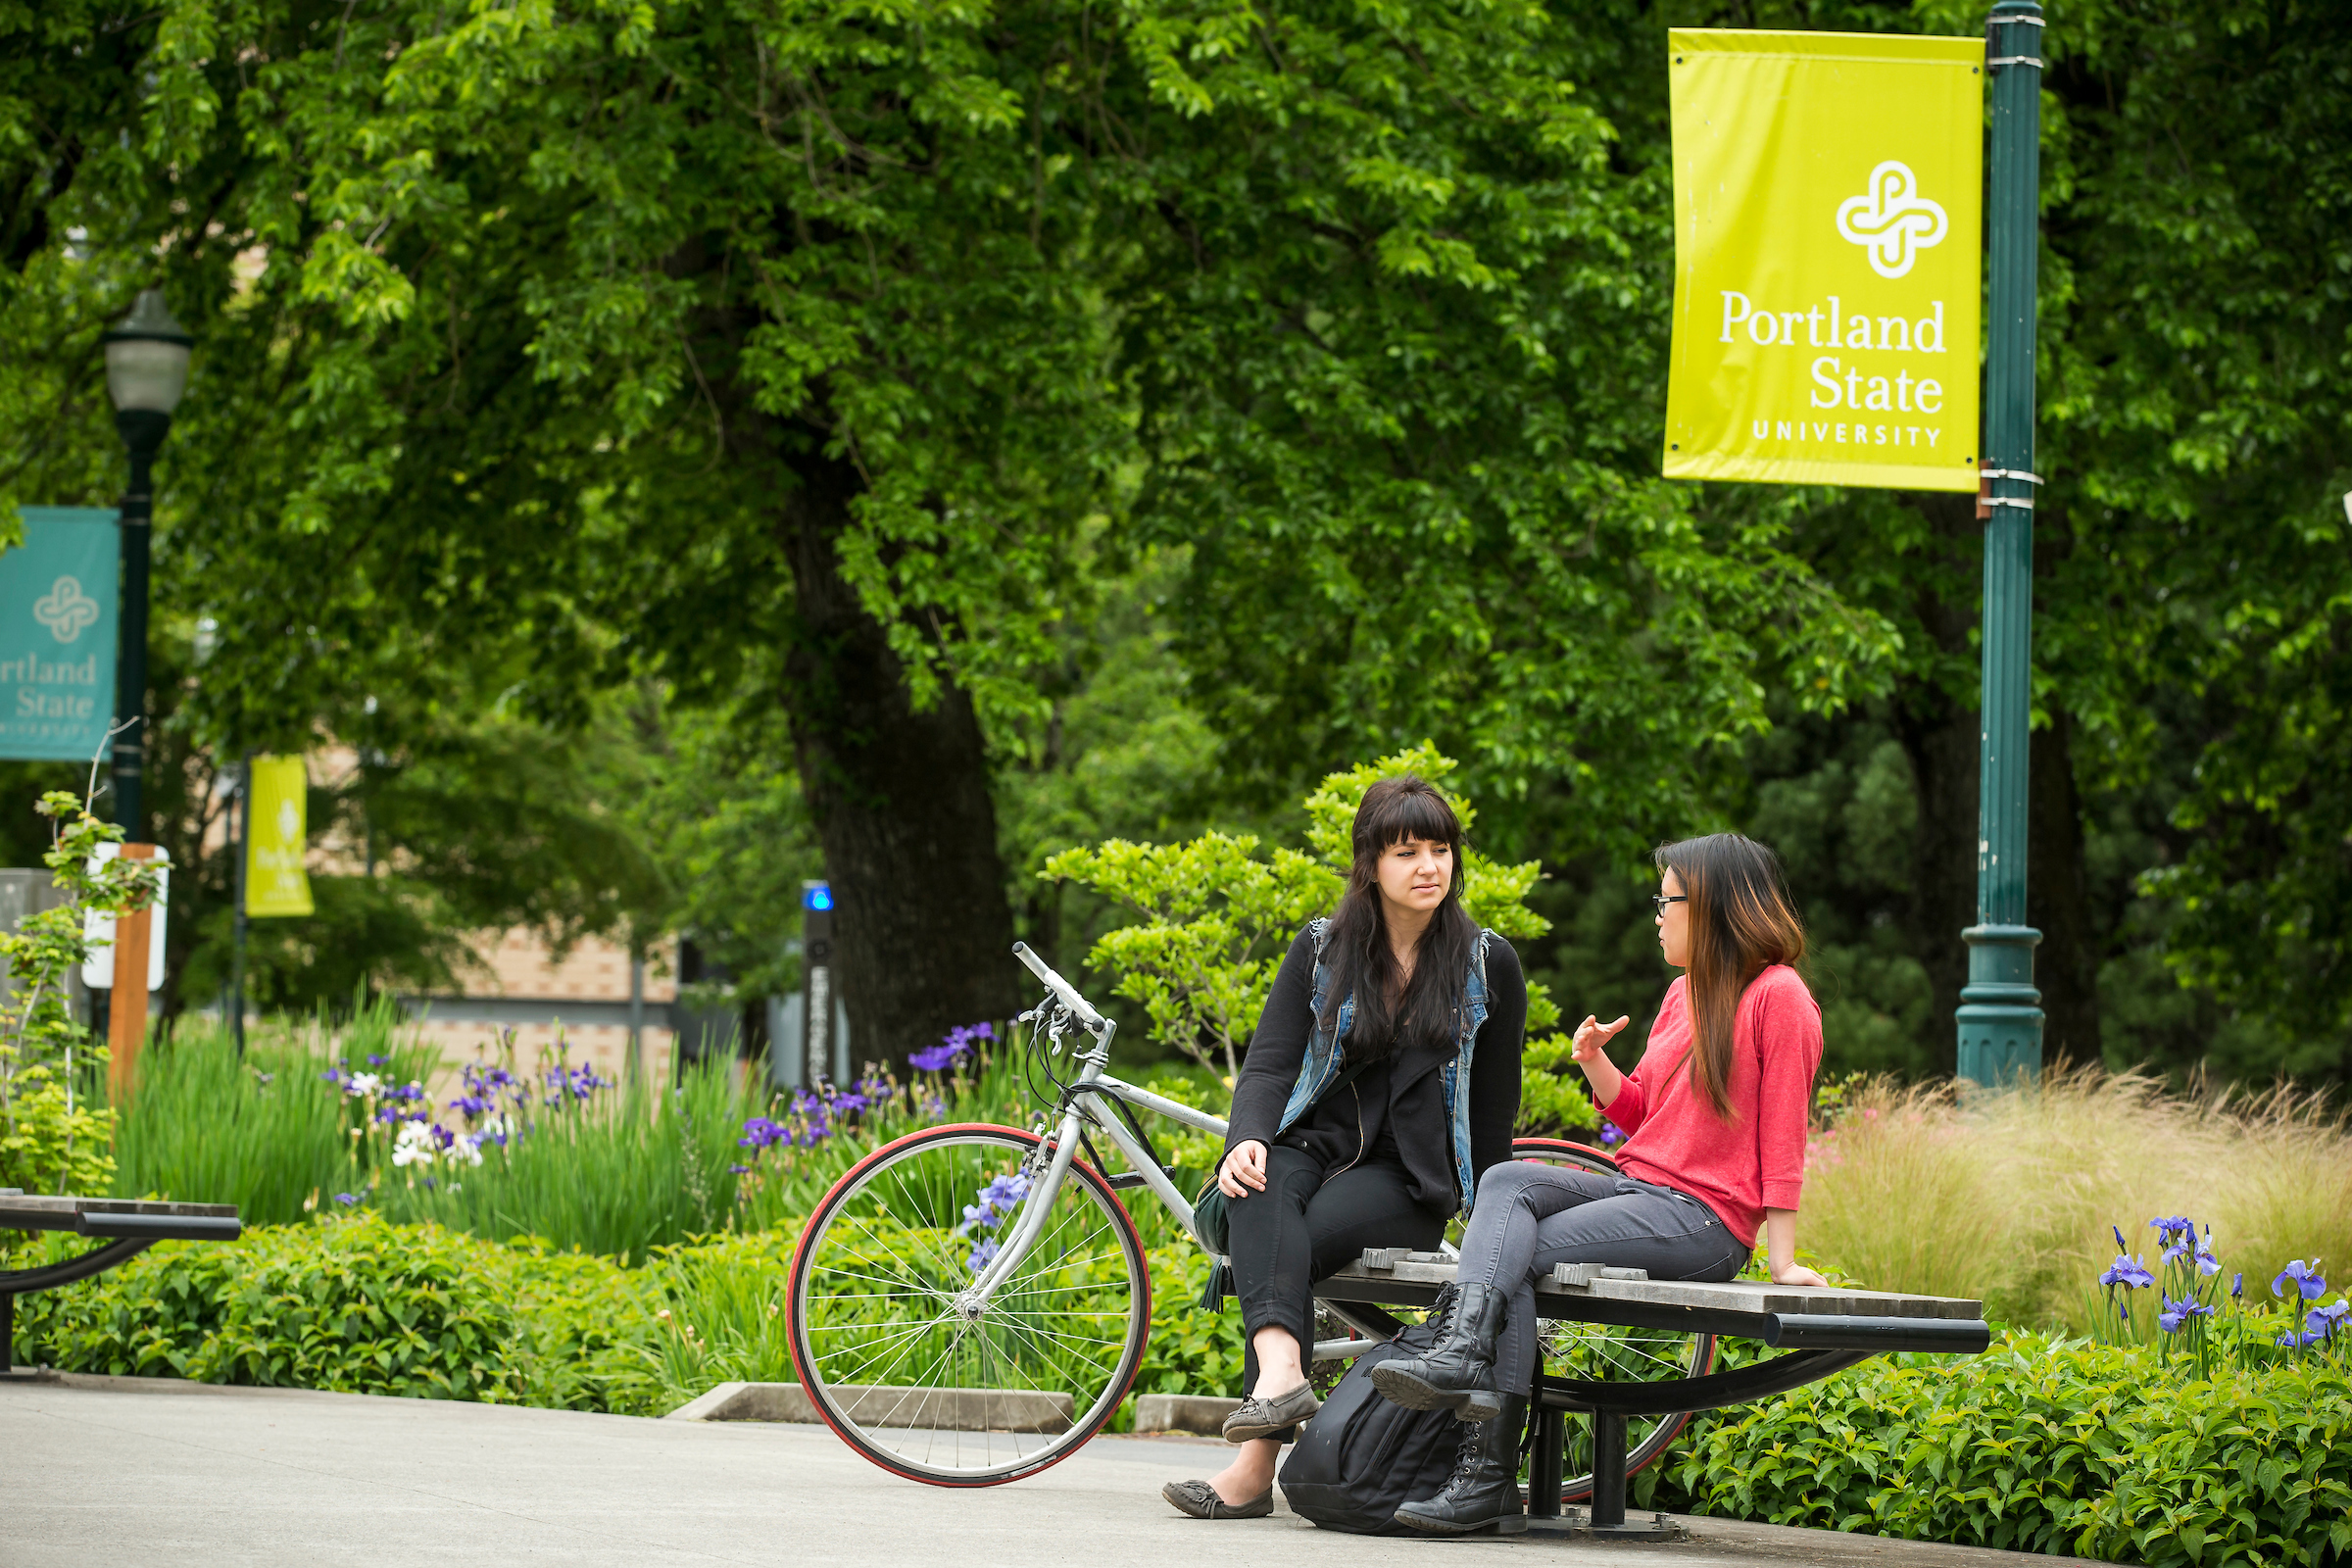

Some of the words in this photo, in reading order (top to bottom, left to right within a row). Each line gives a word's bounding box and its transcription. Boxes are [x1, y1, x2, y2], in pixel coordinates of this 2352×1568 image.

[1719, 290, 1947, 354] Portland
[1810, 356, 1943, 414] State
[1752, 419, 1941, 448] UNIVERSITY
[0, 651, 96, 685] rtland
[16, 685, 95, 719] State
